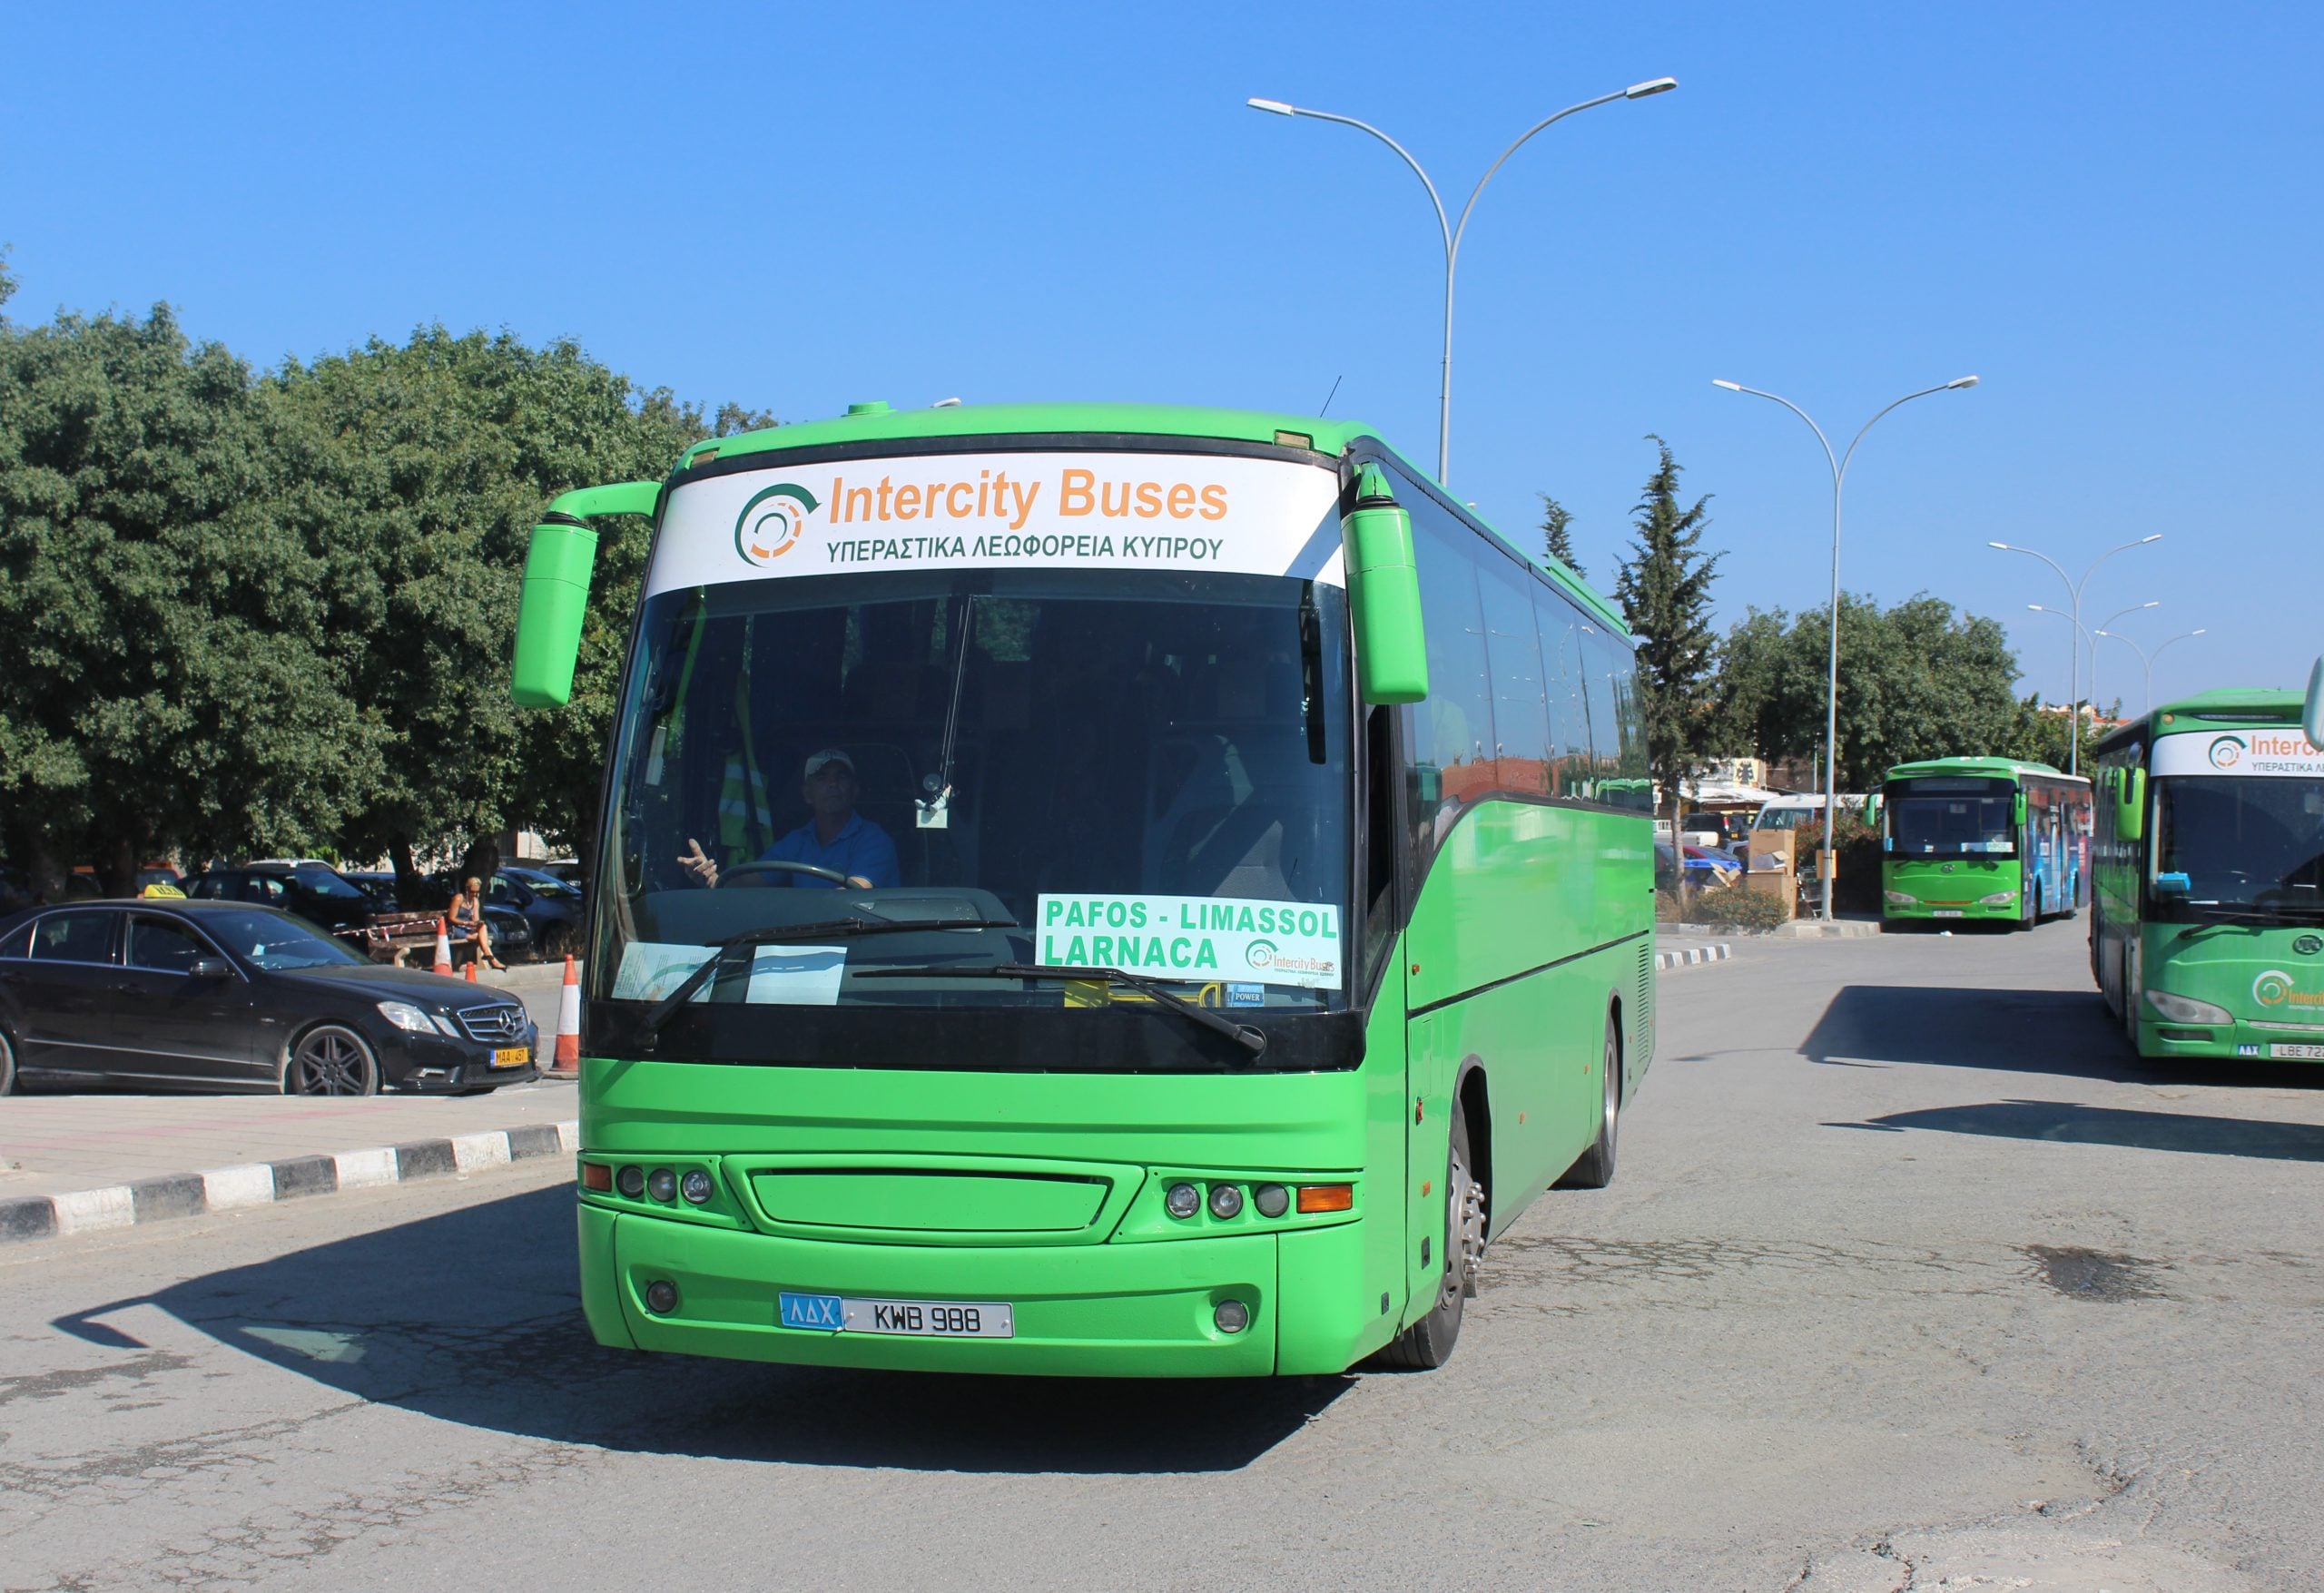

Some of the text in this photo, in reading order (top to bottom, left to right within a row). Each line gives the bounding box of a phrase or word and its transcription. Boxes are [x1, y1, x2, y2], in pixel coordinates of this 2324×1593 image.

[830, 467, 1229, 530] Intercity Buses
[826, 534, 1224, 563] ΥΠΕΡΑΣΤΙΚΑ ΛΕΩΦΟΡΕΙΑ ΚΥΠΡΟΥ
[2251, 762, 2313, 772] ΥΠΕΡΑΣΤΙΚΑ
[1046, 900, 1147, 929] PAFOS
[1180, 903, 1337, 939] LIMASSOL
[1045, 935, 1218, 969] LARNACA
[1274, 954, 1309, 970] Intercity
[1236, 993, 1260, 1002] POWER
[2280, 1046, 2303, 1057] LBE
[874, 1304, 981, 1332] KWB 988
